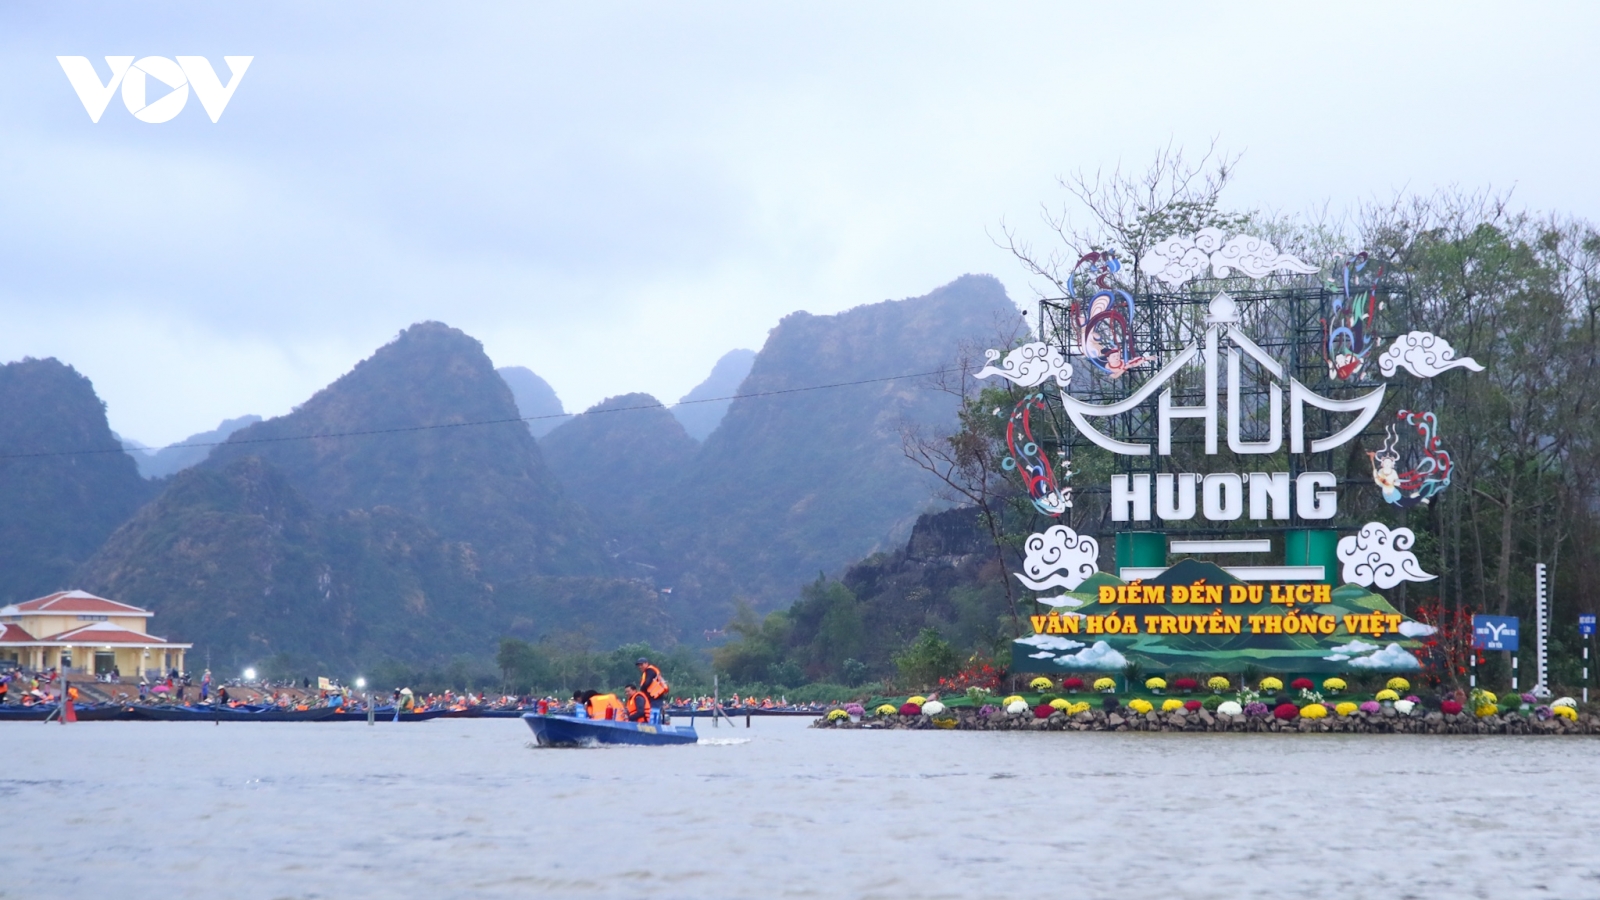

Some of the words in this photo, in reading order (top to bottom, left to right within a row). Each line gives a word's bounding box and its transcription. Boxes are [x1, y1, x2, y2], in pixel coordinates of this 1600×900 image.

[1111, 471, 1338, 522] HƯƠNG
[1098, 578, 1166, 604] ĐIỂM
[1171, 578, 1224, 604] ĐẾN
[1229, 584, 1264, 604] DU
[1270, 584, 1332, 608] LỊCH
[1030, 611, 1080, 635] VĂN
[1086, 610, 1139, 635] HÓA
[1144, 607, 1242, 635] TRUYỀN
[1248, 608, 1337, 635] THỐNG
[1343, 610, 1402, 638] VIỆT
